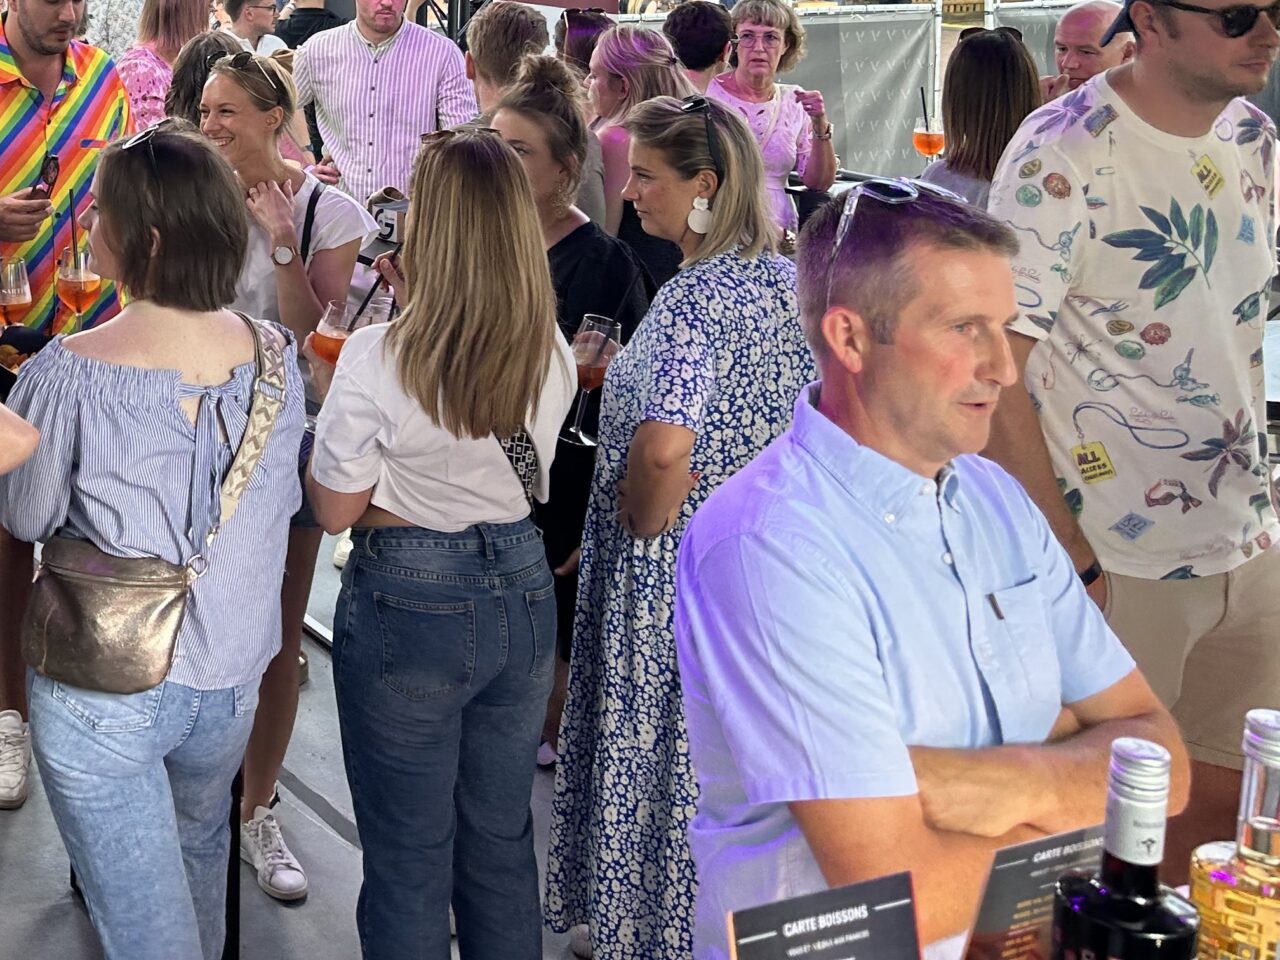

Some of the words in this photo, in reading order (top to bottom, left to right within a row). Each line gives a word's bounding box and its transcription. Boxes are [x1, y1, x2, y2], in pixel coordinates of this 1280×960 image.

[1033, 845, 1063, 863] CARTE
[783, 917, 817, 938] CARTE
[817, 904, 869, 929] BOISSONS
